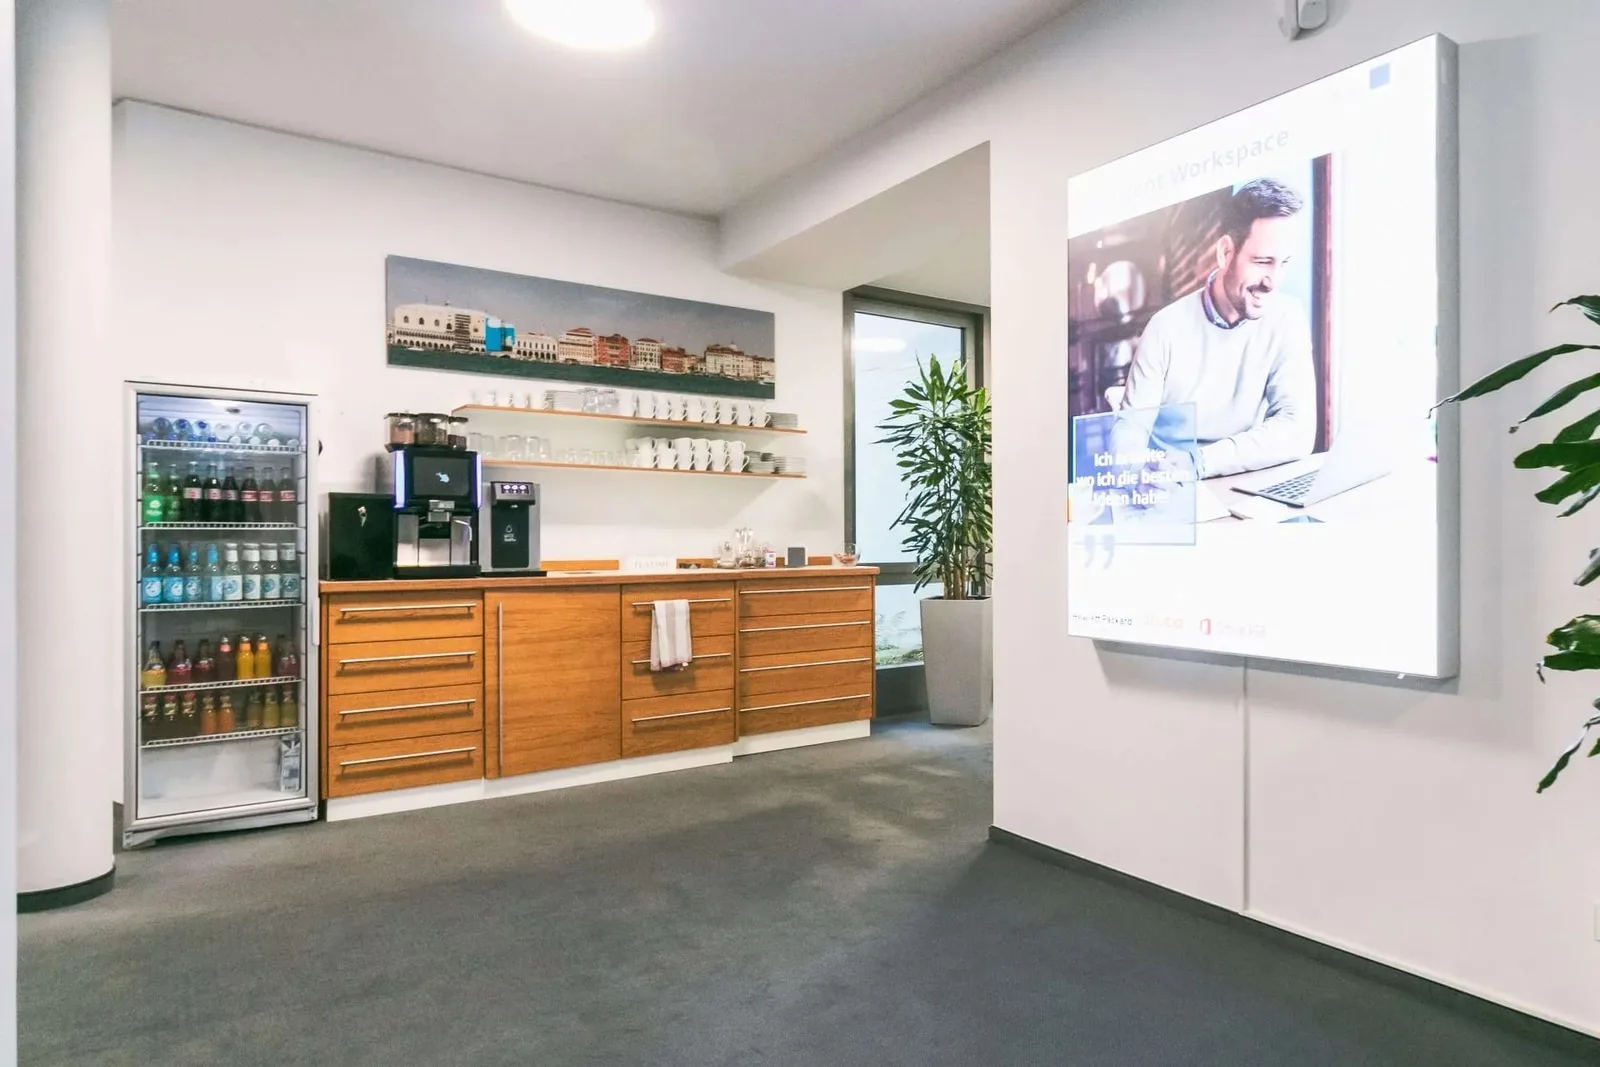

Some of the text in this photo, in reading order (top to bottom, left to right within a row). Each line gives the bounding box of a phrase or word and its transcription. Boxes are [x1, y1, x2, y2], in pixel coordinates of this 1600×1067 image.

[1170, 129, 1290, 186] Workspace
[1094, 452, 1113, 467] Ich
[1097, 471, 1116, 487] ich
[1117, 470, 1139, 486] die
